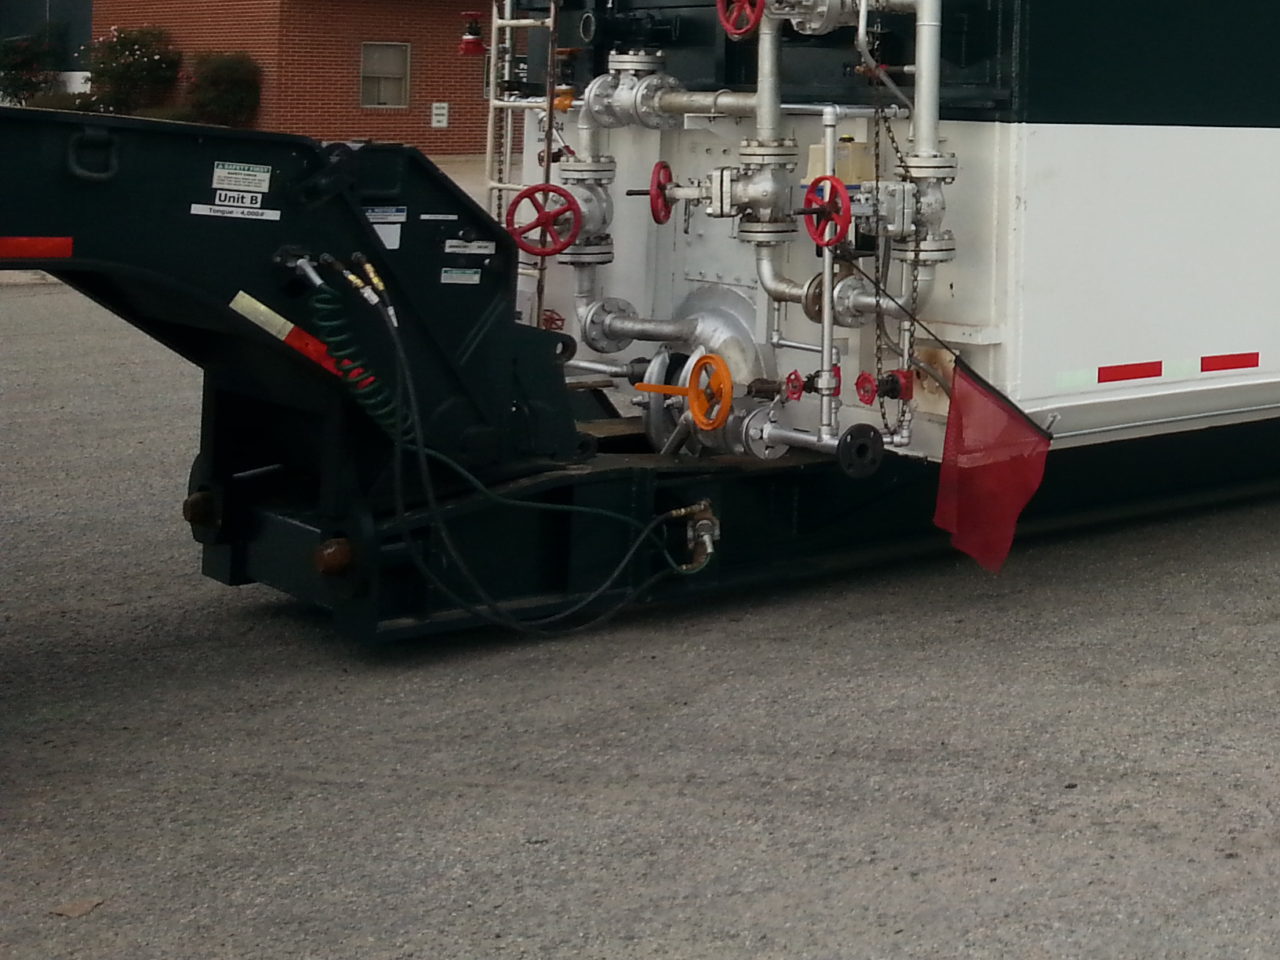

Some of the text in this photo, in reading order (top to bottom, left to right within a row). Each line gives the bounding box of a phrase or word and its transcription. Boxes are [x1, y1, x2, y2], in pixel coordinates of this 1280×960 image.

[218, 192, 259, 205] Unit B
[208, 207, 234, 216] Tongue
